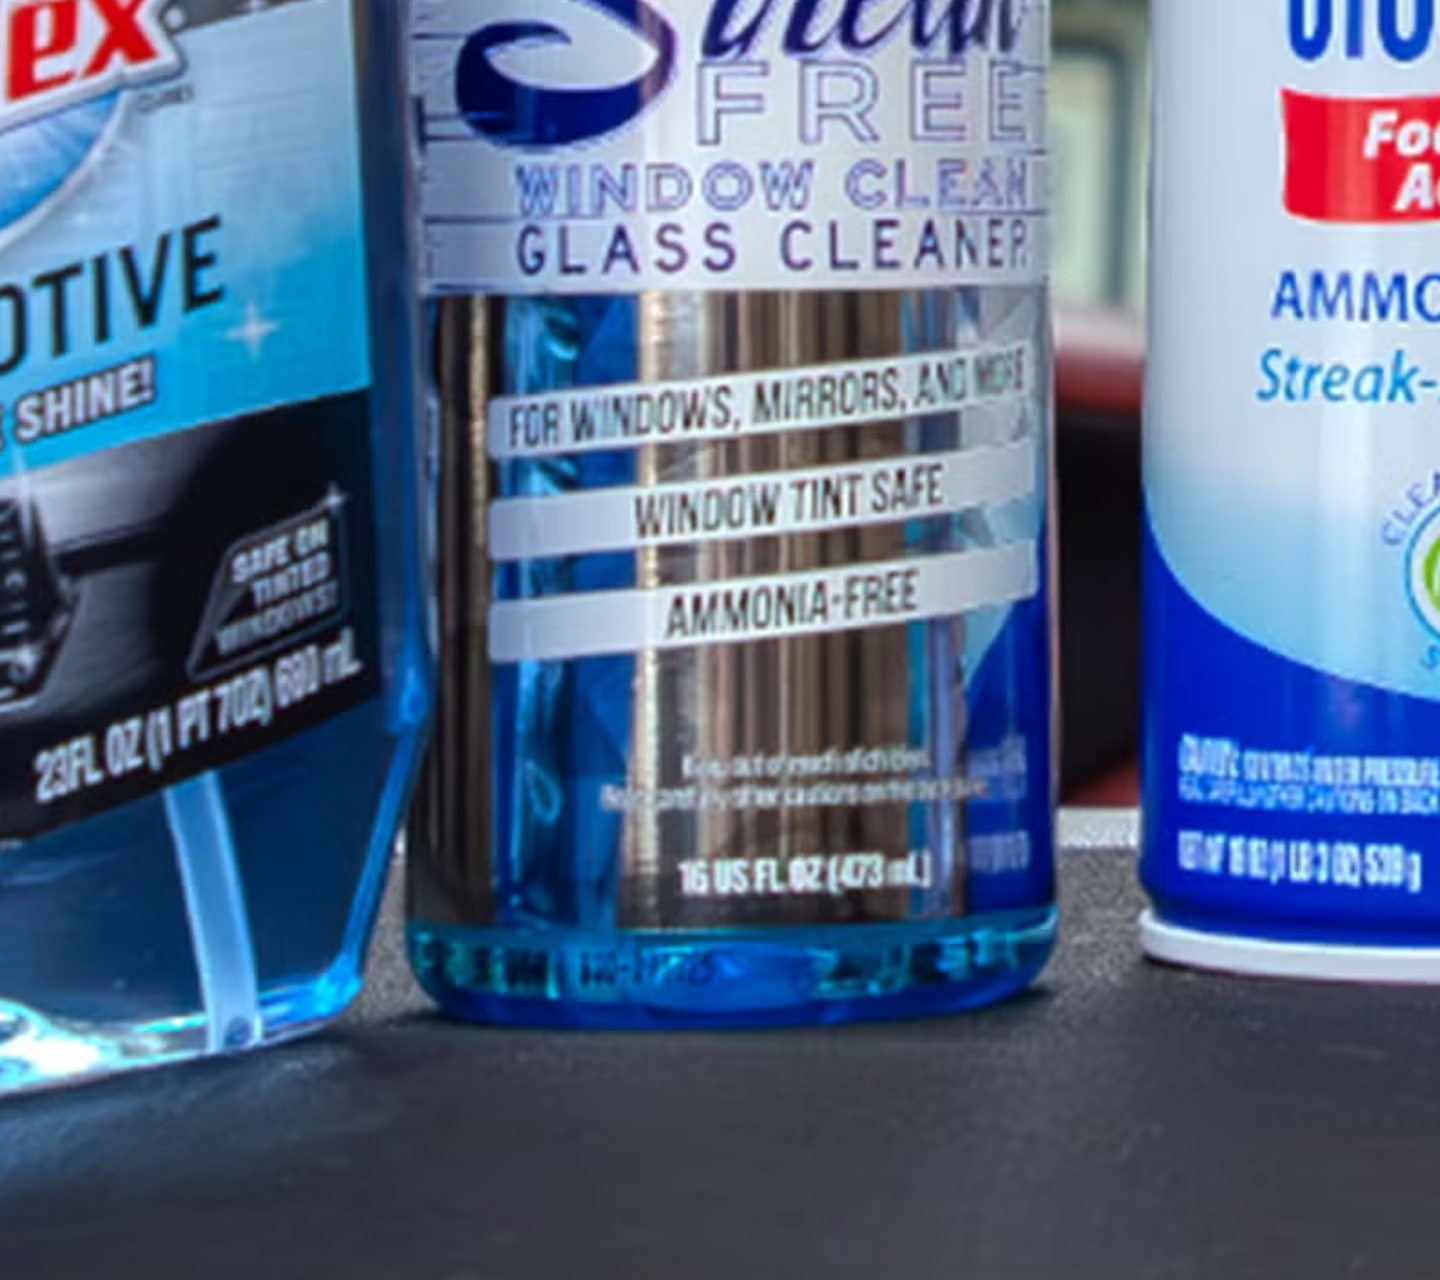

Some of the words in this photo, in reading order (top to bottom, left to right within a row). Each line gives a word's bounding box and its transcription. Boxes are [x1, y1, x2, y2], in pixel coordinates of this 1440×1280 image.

[696, 59, 1028, 145] FREE
[515, 159, 814, 217] WINDOW
[844, 156, 1026, 209] CLEAN
[516, 221, 737, 276] GLASS
[780, 218, 1027, 272] CLEANER
[14, 360, 154, 442] SHINE!
[509, 401, 558, 449] FOR
[570, 384, 741, 442] WINDOWS,
[755, 366, 908, 424] MIRRORS,
[915, 356, 965, 404] AND
[635, 486, 782, 538] WINDOW
[791, 473, 861, 522] TINT
[871, 462, 945, 513] SAFE
[666, 568, 920, 637] AMMONIA-FREE
[715, 856, 749, 894] US
